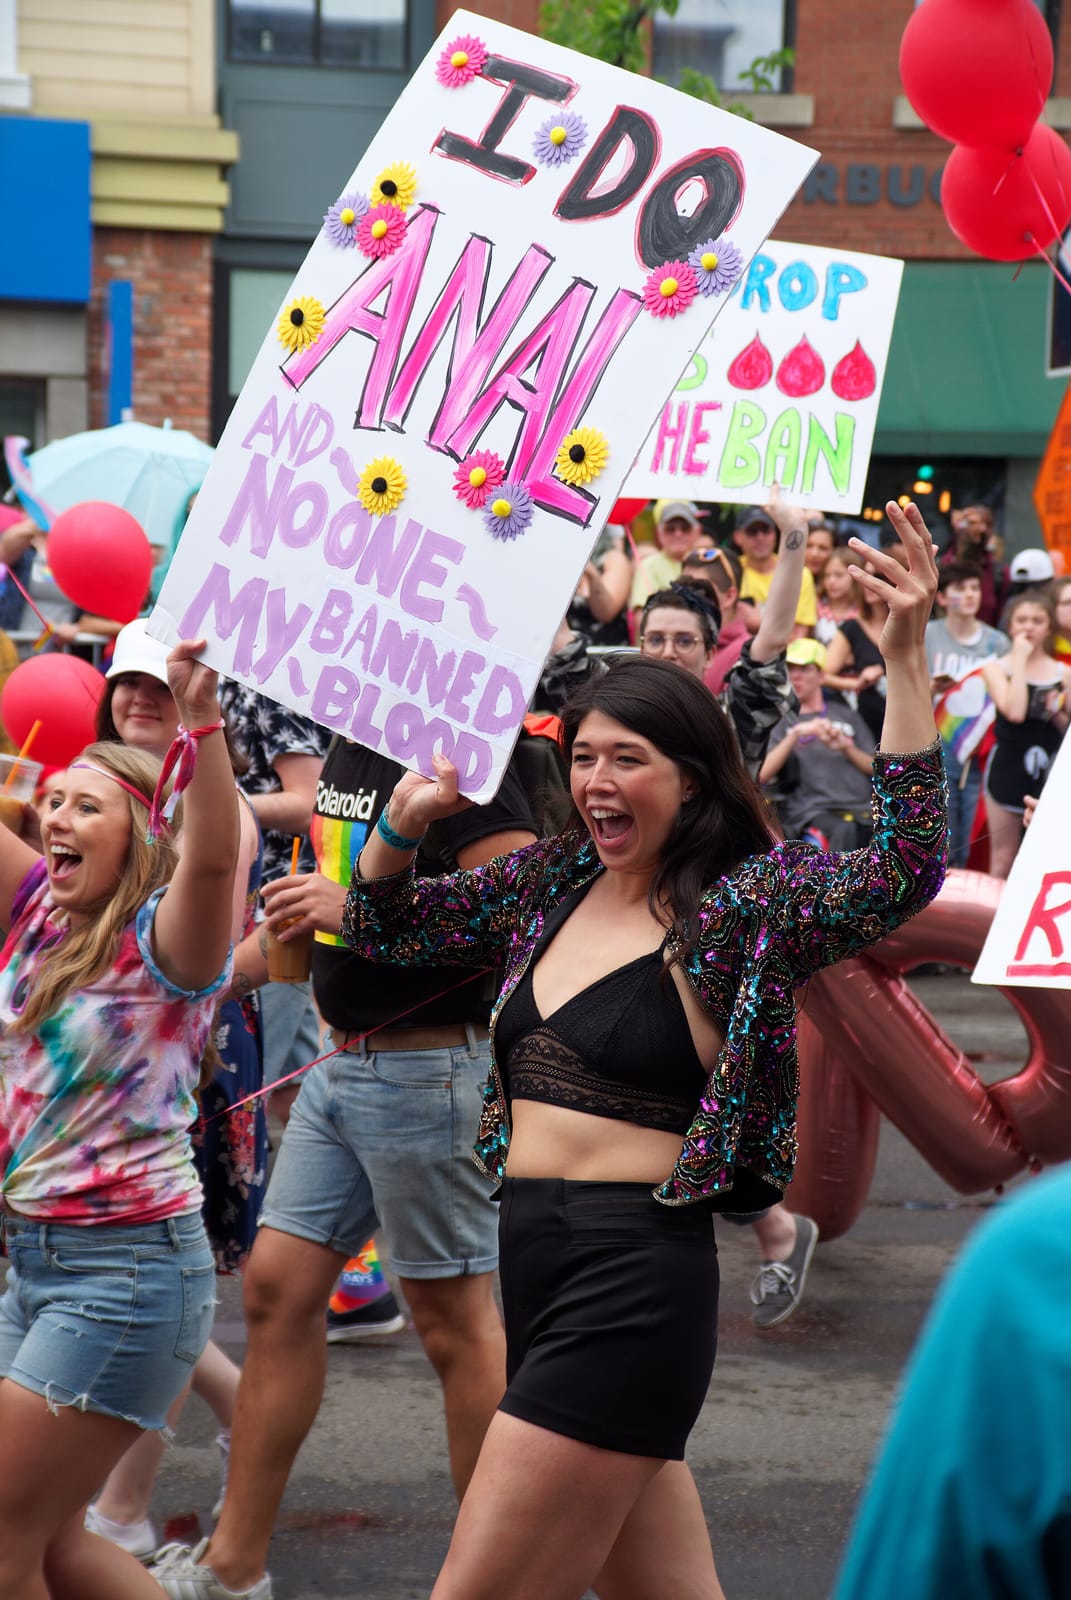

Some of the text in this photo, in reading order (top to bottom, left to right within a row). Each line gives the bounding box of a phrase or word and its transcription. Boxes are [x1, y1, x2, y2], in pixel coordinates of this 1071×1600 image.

[430, 53, 746, 269] I DO
[730, 254, 868, 321] ROP
[241, 394, 335, 468] AND
[279, 201, 644, 528] ANAL
[633, 400, 856, 497] HE BAN
[218, 454, 466, 625] NO ONE
[176, 562, 528, 735] MY BANNED
[310, 665, 494, 794] BLOOD
